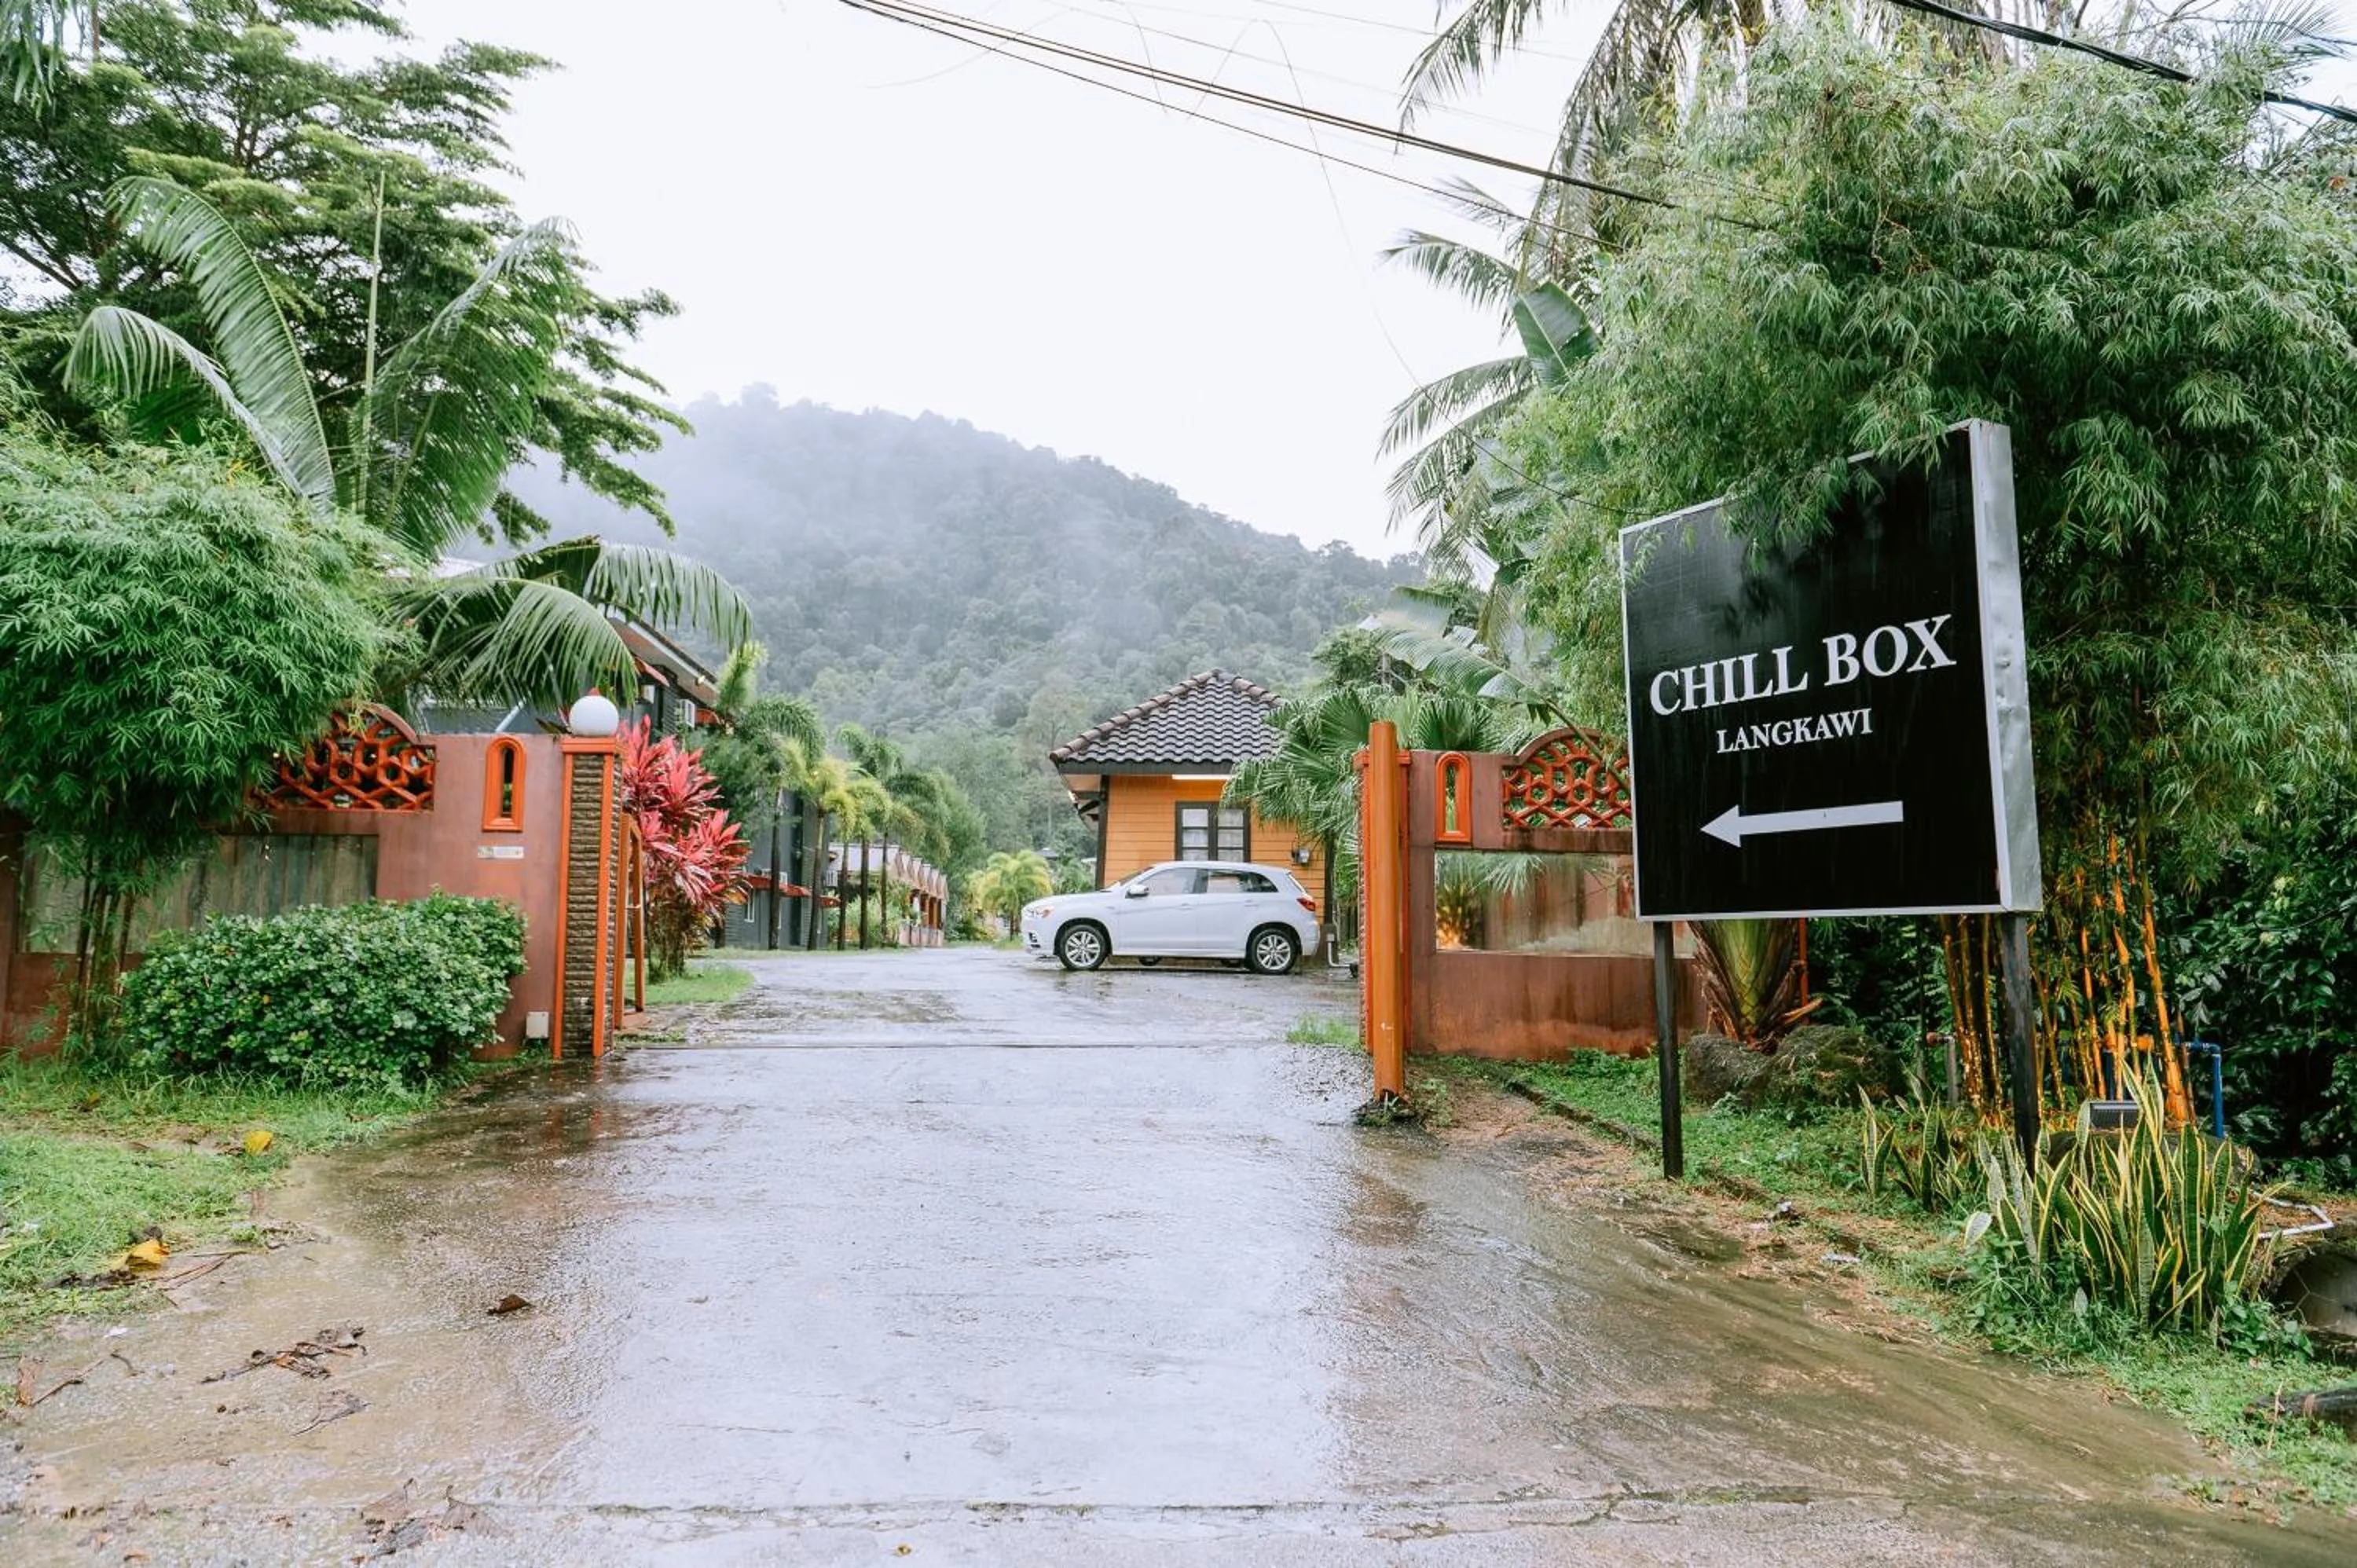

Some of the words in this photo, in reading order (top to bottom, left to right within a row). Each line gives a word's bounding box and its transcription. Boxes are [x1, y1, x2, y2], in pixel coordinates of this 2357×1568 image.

[1650, 647, 1808, 716] CHILL
[1823, 614, 1957, 687] BOX
[1716, 708, 1873, 754] LANGKAWI
